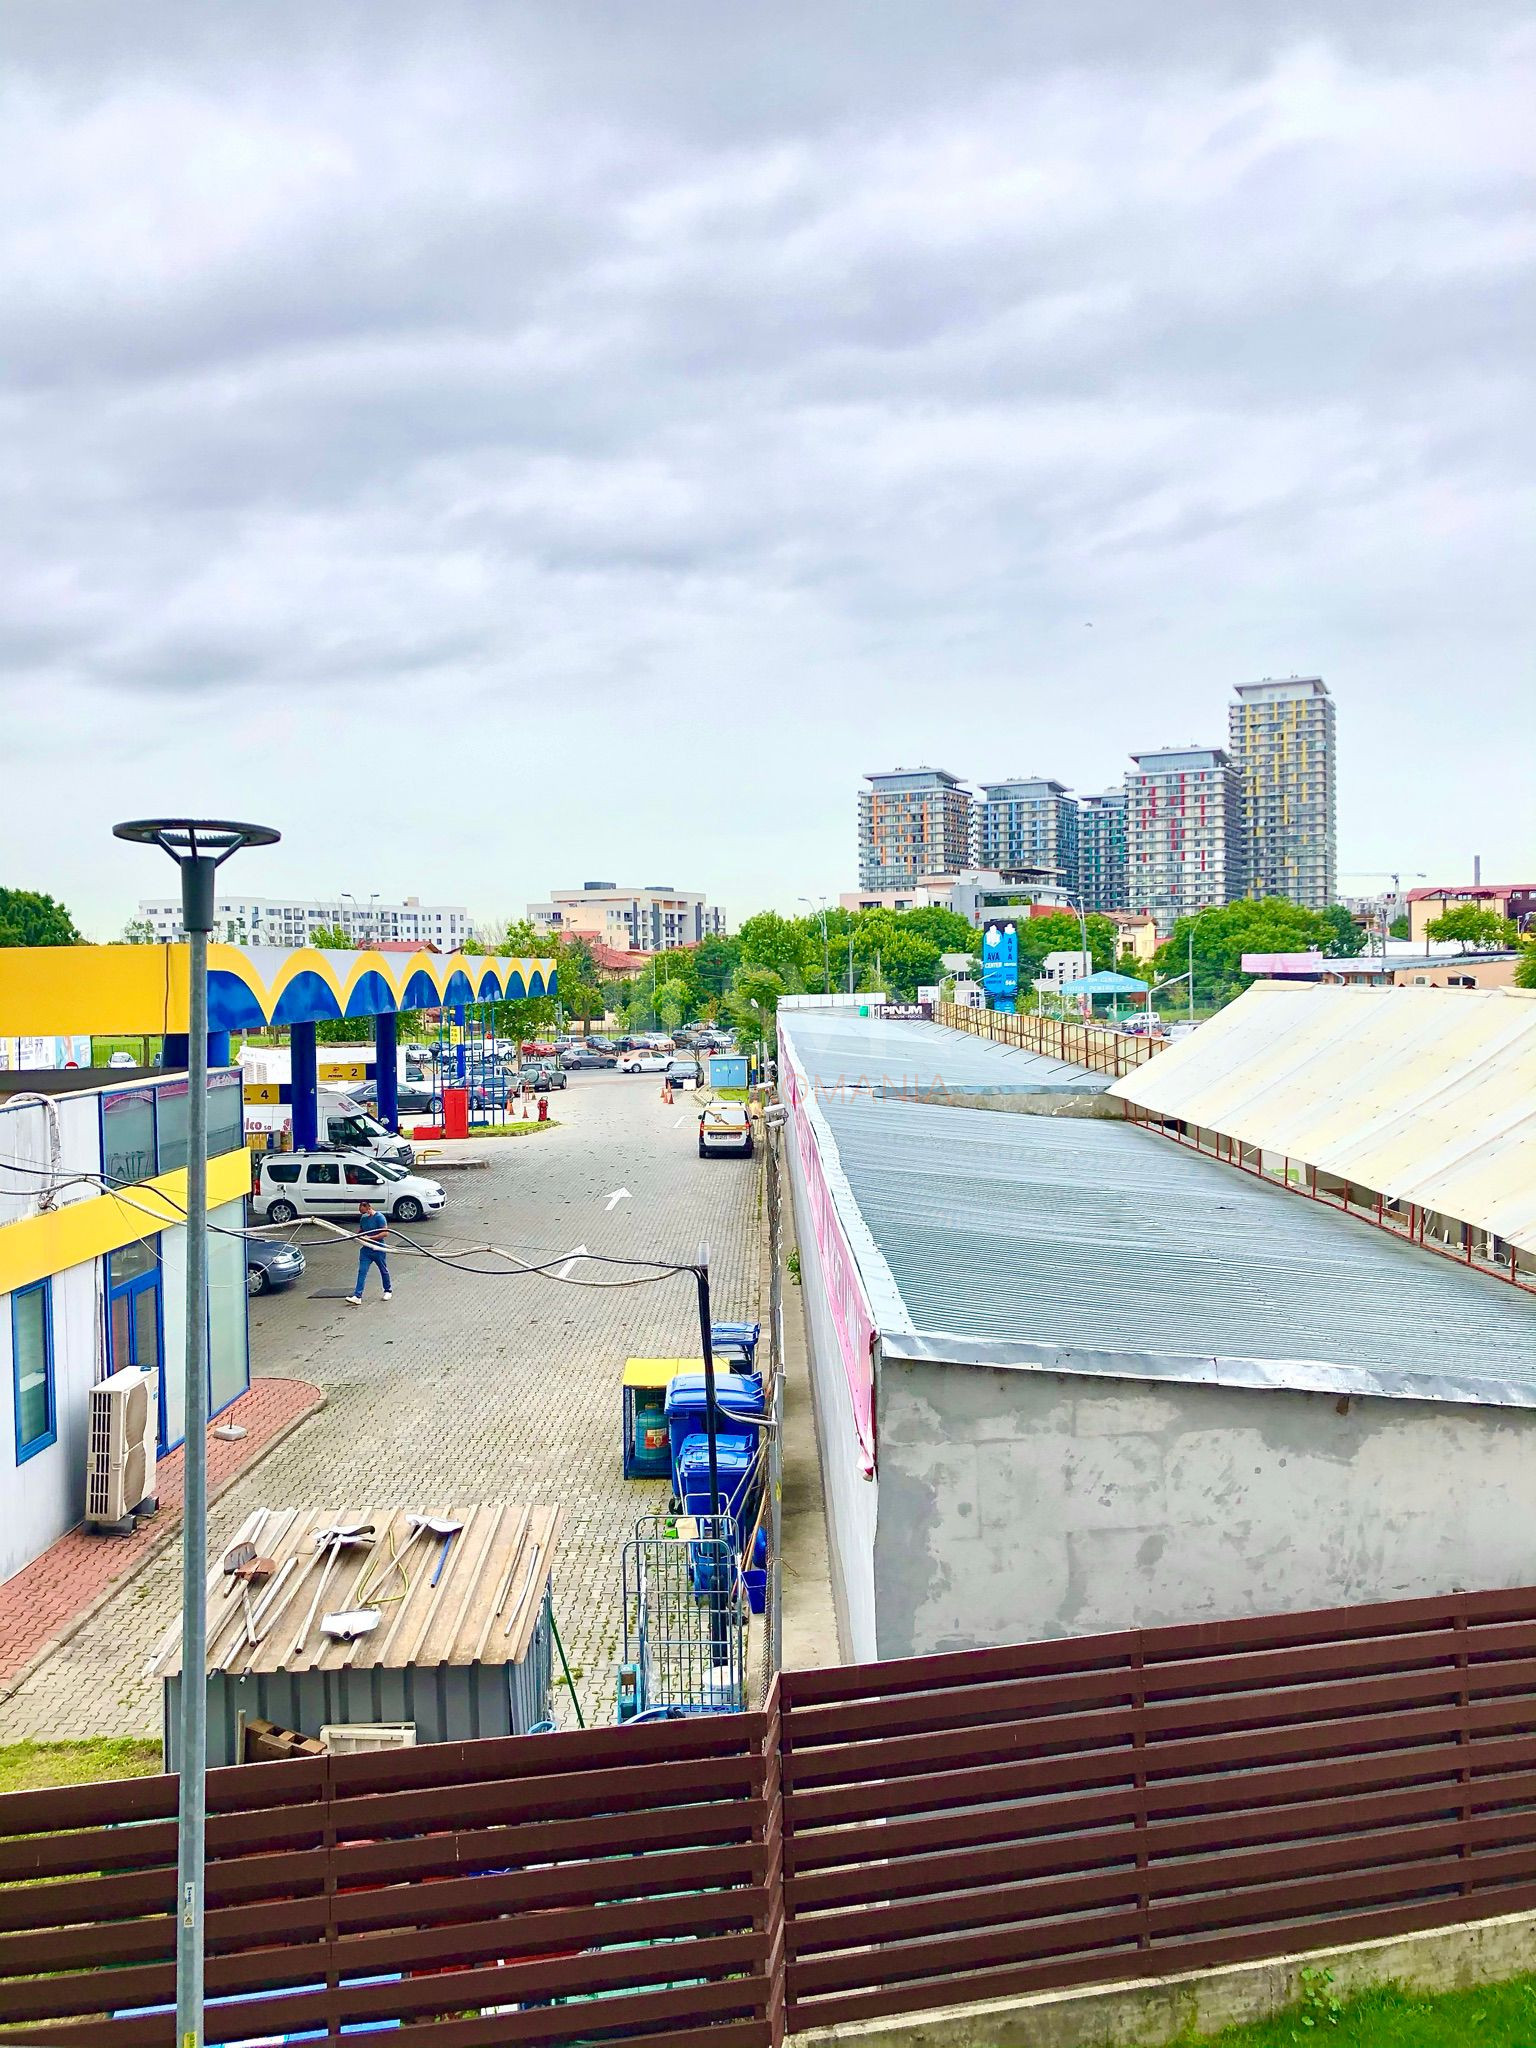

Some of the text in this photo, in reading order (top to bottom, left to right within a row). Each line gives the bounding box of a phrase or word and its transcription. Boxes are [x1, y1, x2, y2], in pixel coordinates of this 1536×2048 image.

[987, 952, 1000, 961] AVA
[881, 1005, 922, 1015] PINUM
[351, 1068, 358, 1077] 2
[260, 1089, 269, 1099] 4
